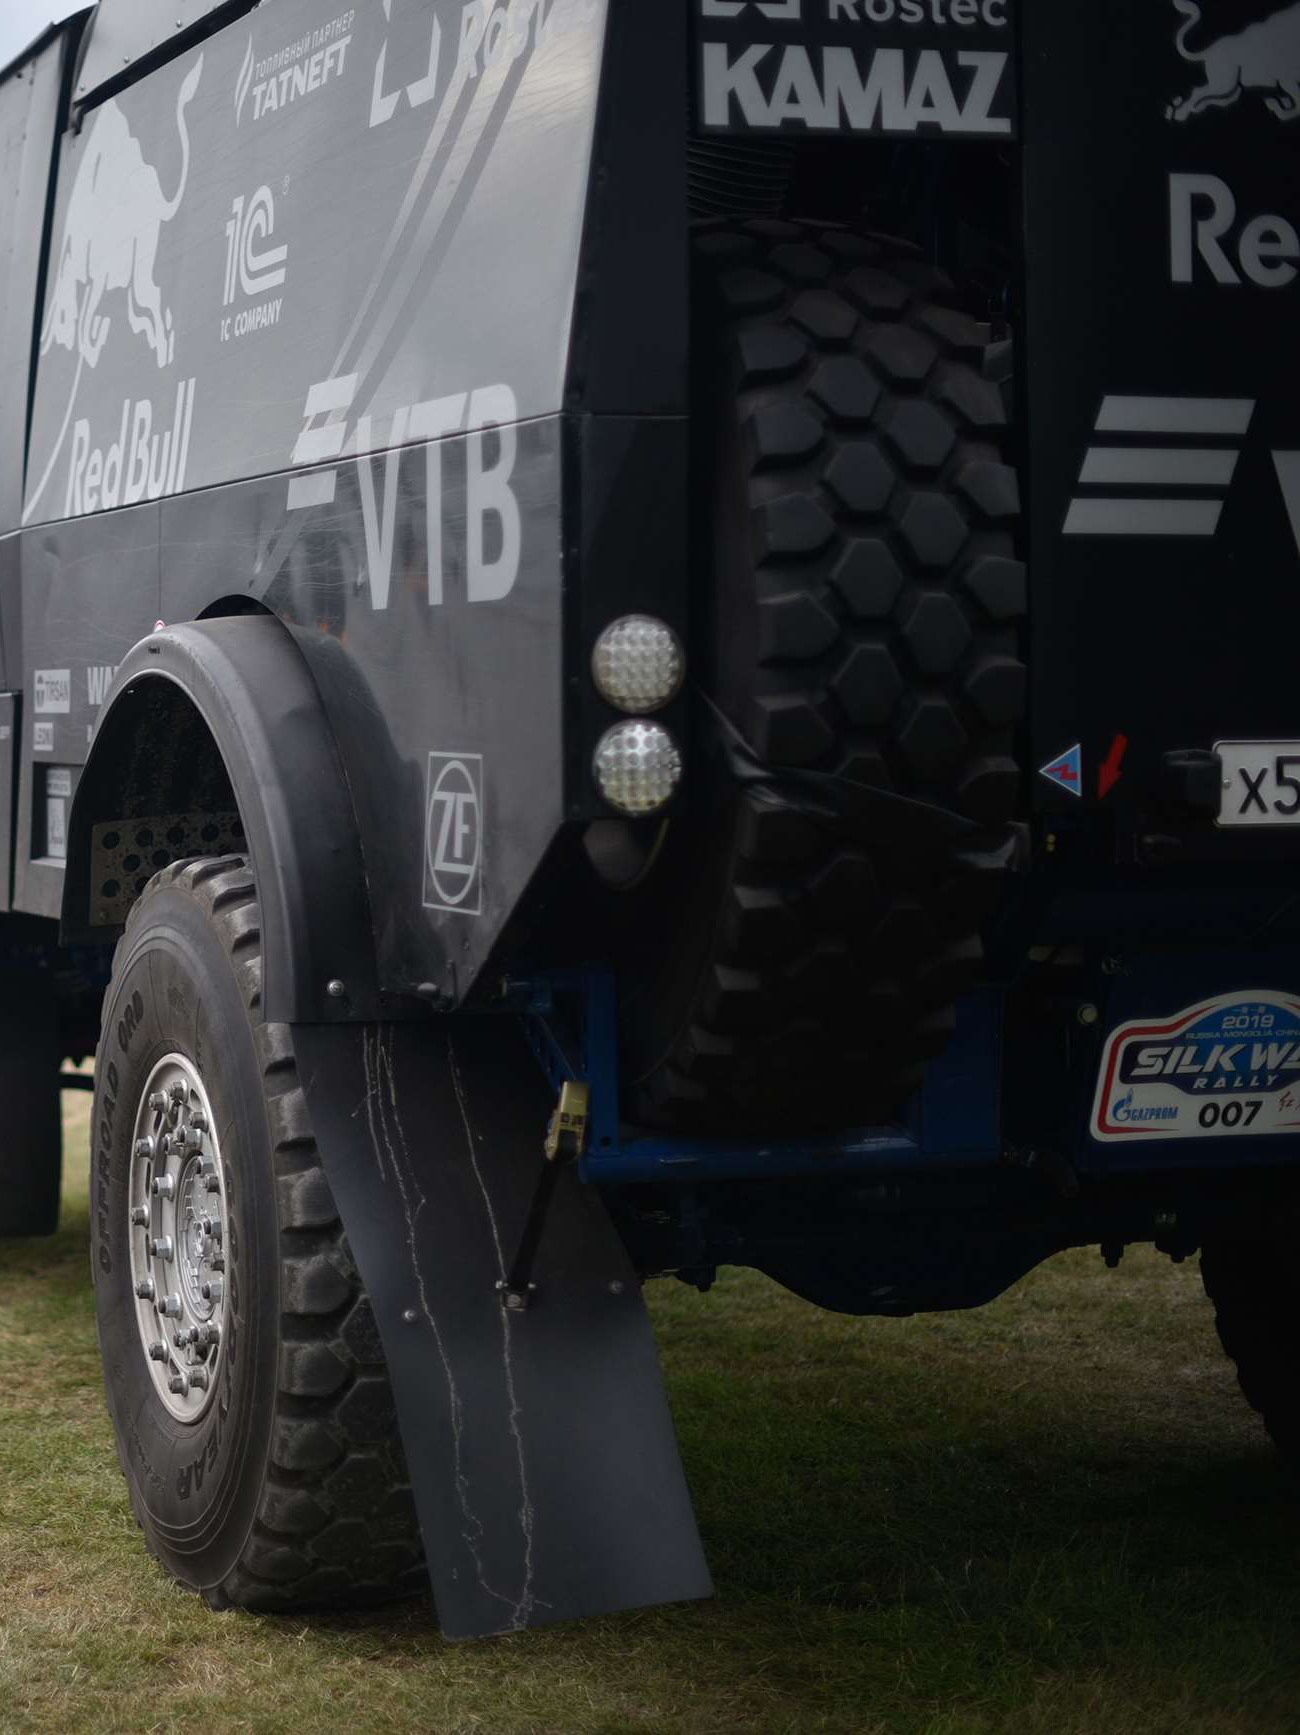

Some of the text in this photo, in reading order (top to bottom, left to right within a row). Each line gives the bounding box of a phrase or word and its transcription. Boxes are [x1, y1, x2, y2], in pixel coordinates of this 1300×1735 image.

[252, 34, 352, 121] TATNEFT
[255, 9, 355, 80] ТОПЛИВНЫЙ ПАРТНЕР
[703, 42, 1011, 133] KAMAZ
[1169, 173, 1300, 288] Re
[234, 297, 283, 337] COMPANY
[356, 383, 521, 610] VTB
[433, 791, 477, 874] ZF
[1130, 1044, 1246, 1076] SILK
[1221, 1014, 1275, 1029] 2019
[1192, 1074, 1279, 1089] RALLY
[1198, 1101, 1263, 1128] 007
[94, 989, 145, 1275] OFFROAD ORD
